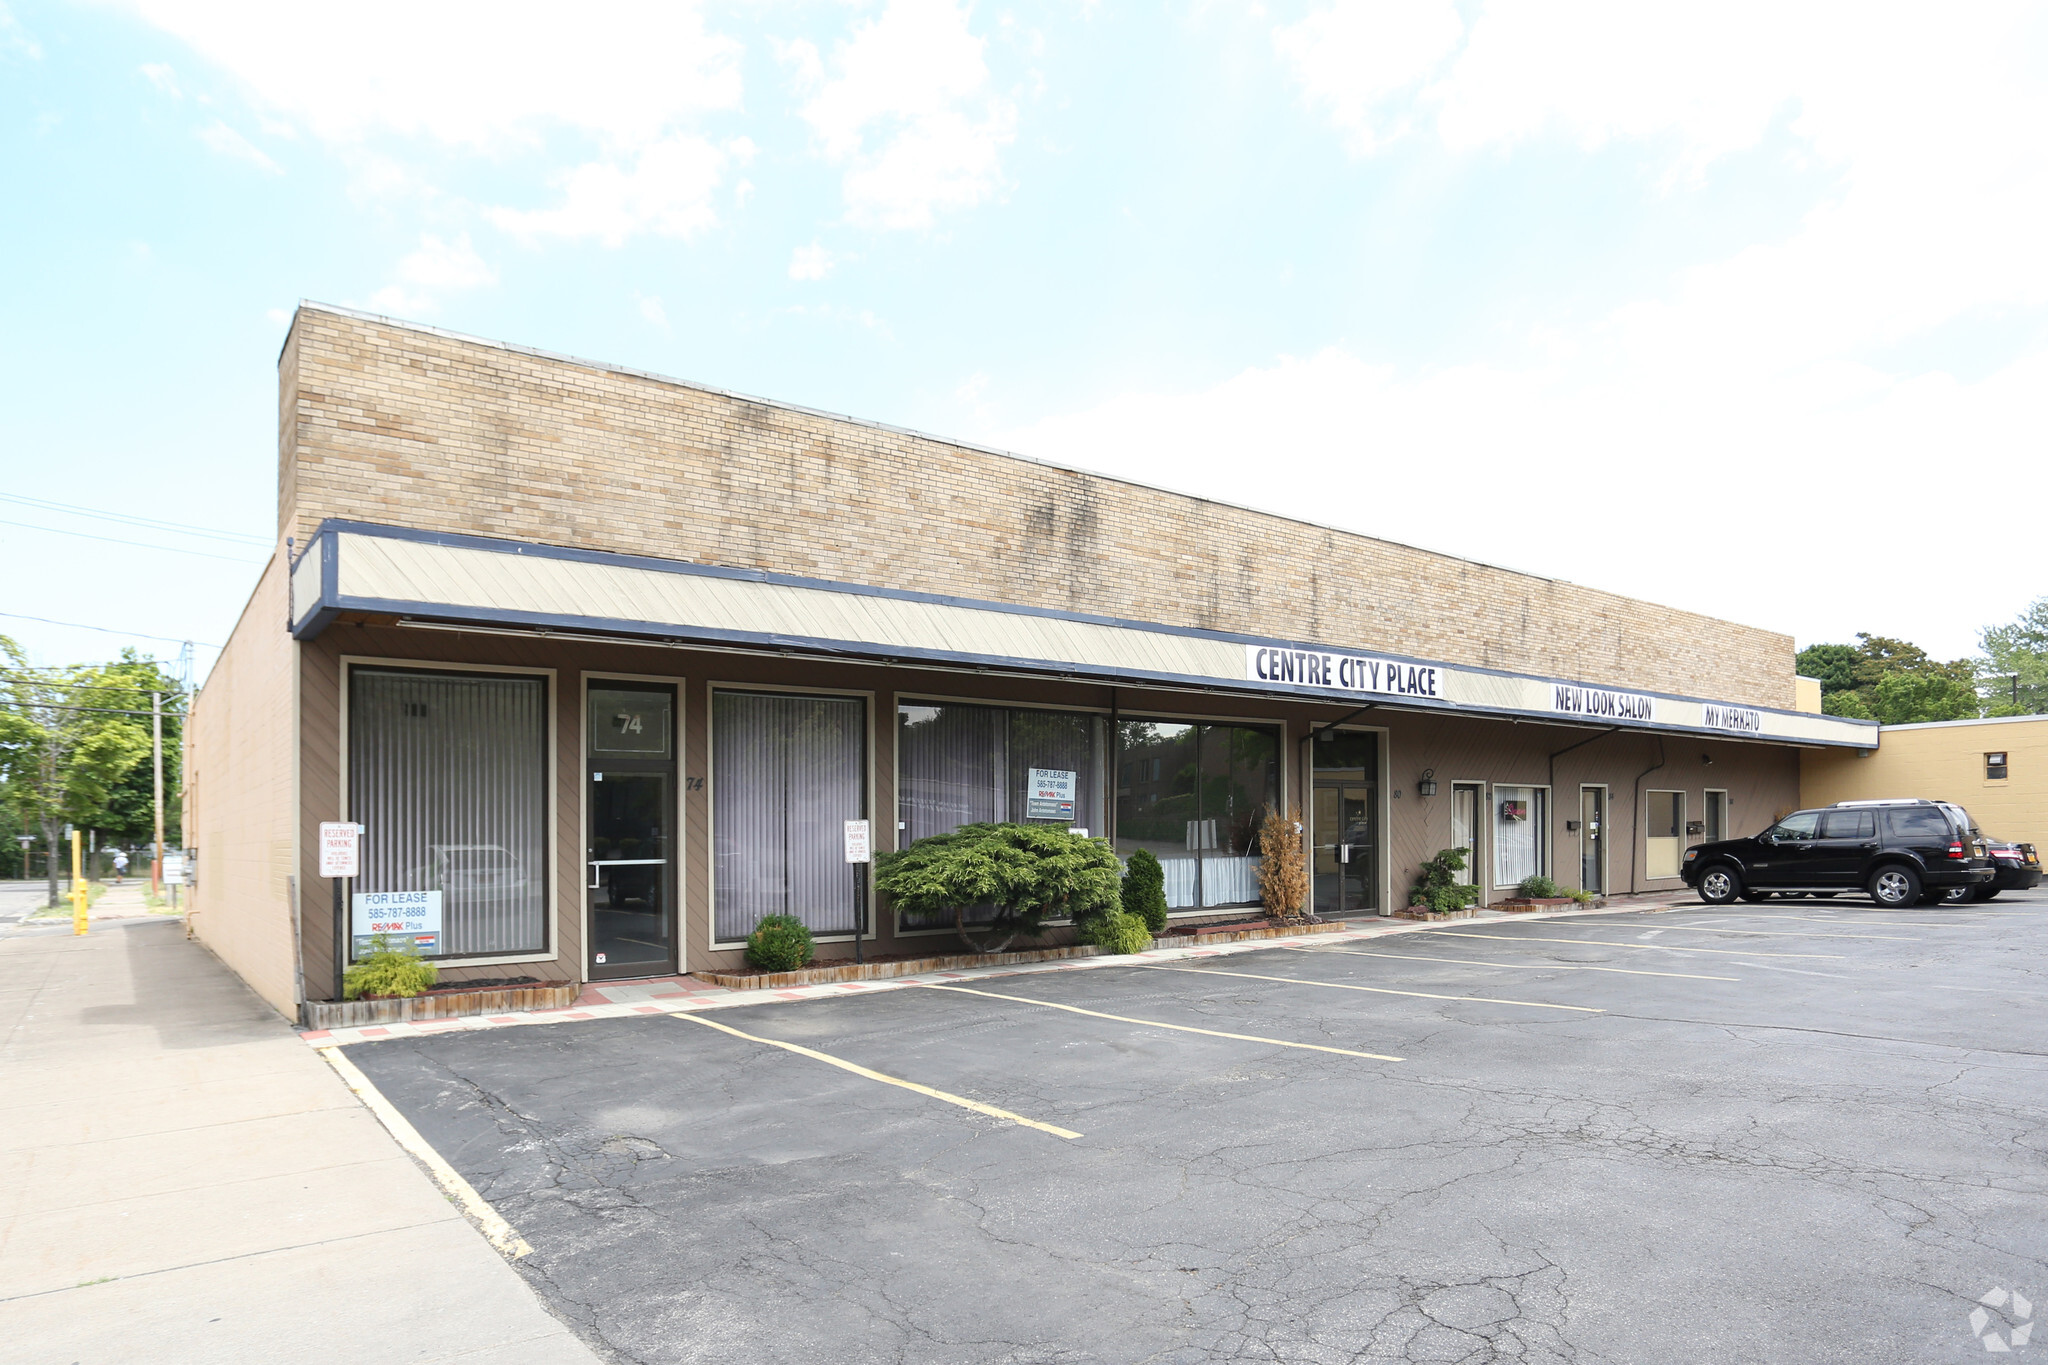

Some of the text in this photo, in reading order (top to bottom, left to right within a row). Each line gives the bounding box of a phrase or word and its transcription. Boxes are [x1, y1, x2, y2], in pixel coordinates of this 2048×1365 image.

[1256, 648, 1436, 696] CENTRE CITY PLACE
[1555, 685, 1652, 720] NEW LOOK SALON
[617, 713, 643, 734] 74
[1705, 705, 1760, 732] MY MERKATO
[1036, 770, 1069, 779] FOR LEASE
[686, 777, 704, 791] 74
[1037, 780, 1068, 789] 585-787-8888
[1039, 790, 1056, 798] RE/MAX
[324, 829, 355, 838] RESERVED
[327, 839, 352, 848] PARKING
[365, 893, 428, 904] FOR LEASE
[368, 906, 426, 919] 585-787-8888
[372, 921, 423, 932] RE/MAX Plus
